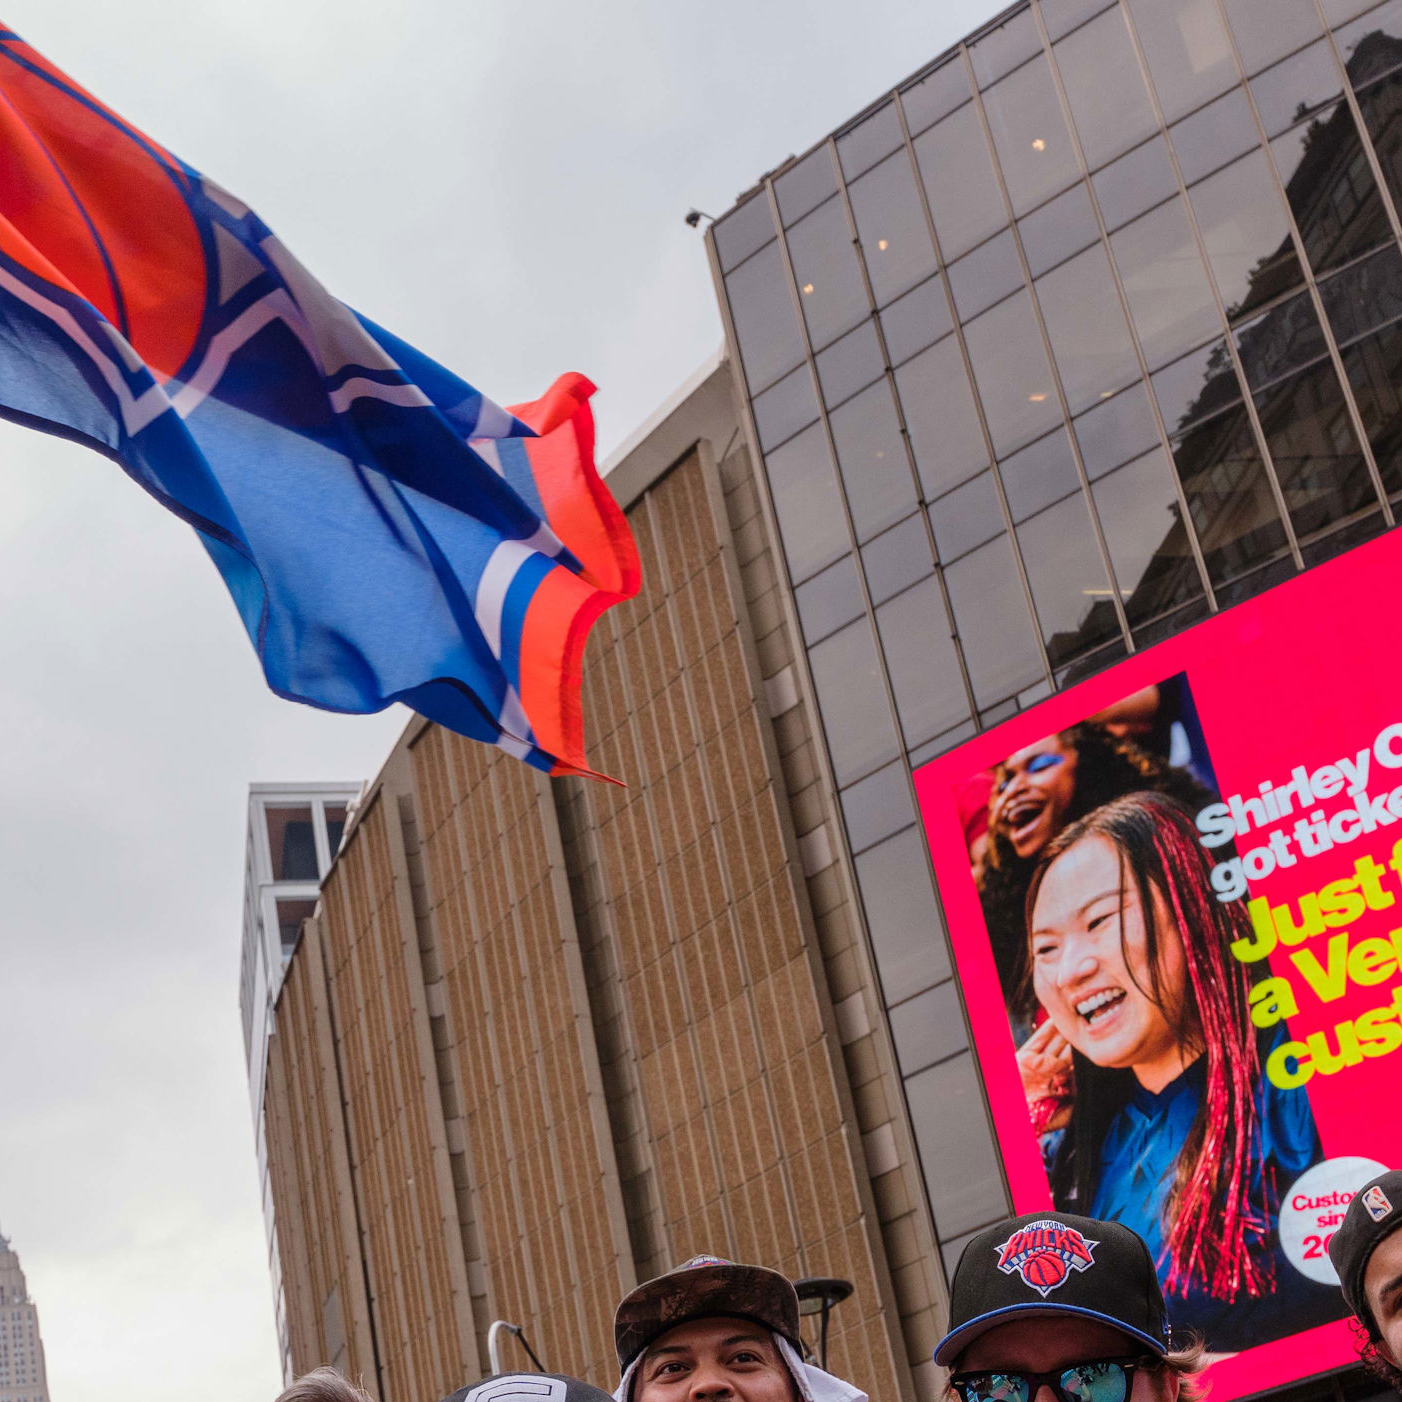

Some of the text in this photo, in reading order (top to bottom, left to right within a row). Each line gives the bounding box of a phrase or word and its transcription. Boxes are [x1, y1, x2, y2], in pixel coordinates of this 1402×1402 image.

[1195, 748, 1370, 848] Shirley
[1209, 829, 1297, 902] got
[1230, 855, 1395, 963] Just
[1248, 976, 1299, 1029] a
[1292, 1191, 1359, 1212] Custo
[1317, 1210, 1346, 1228] sin
[999, 1228, 1092, 1266] KNICKS
